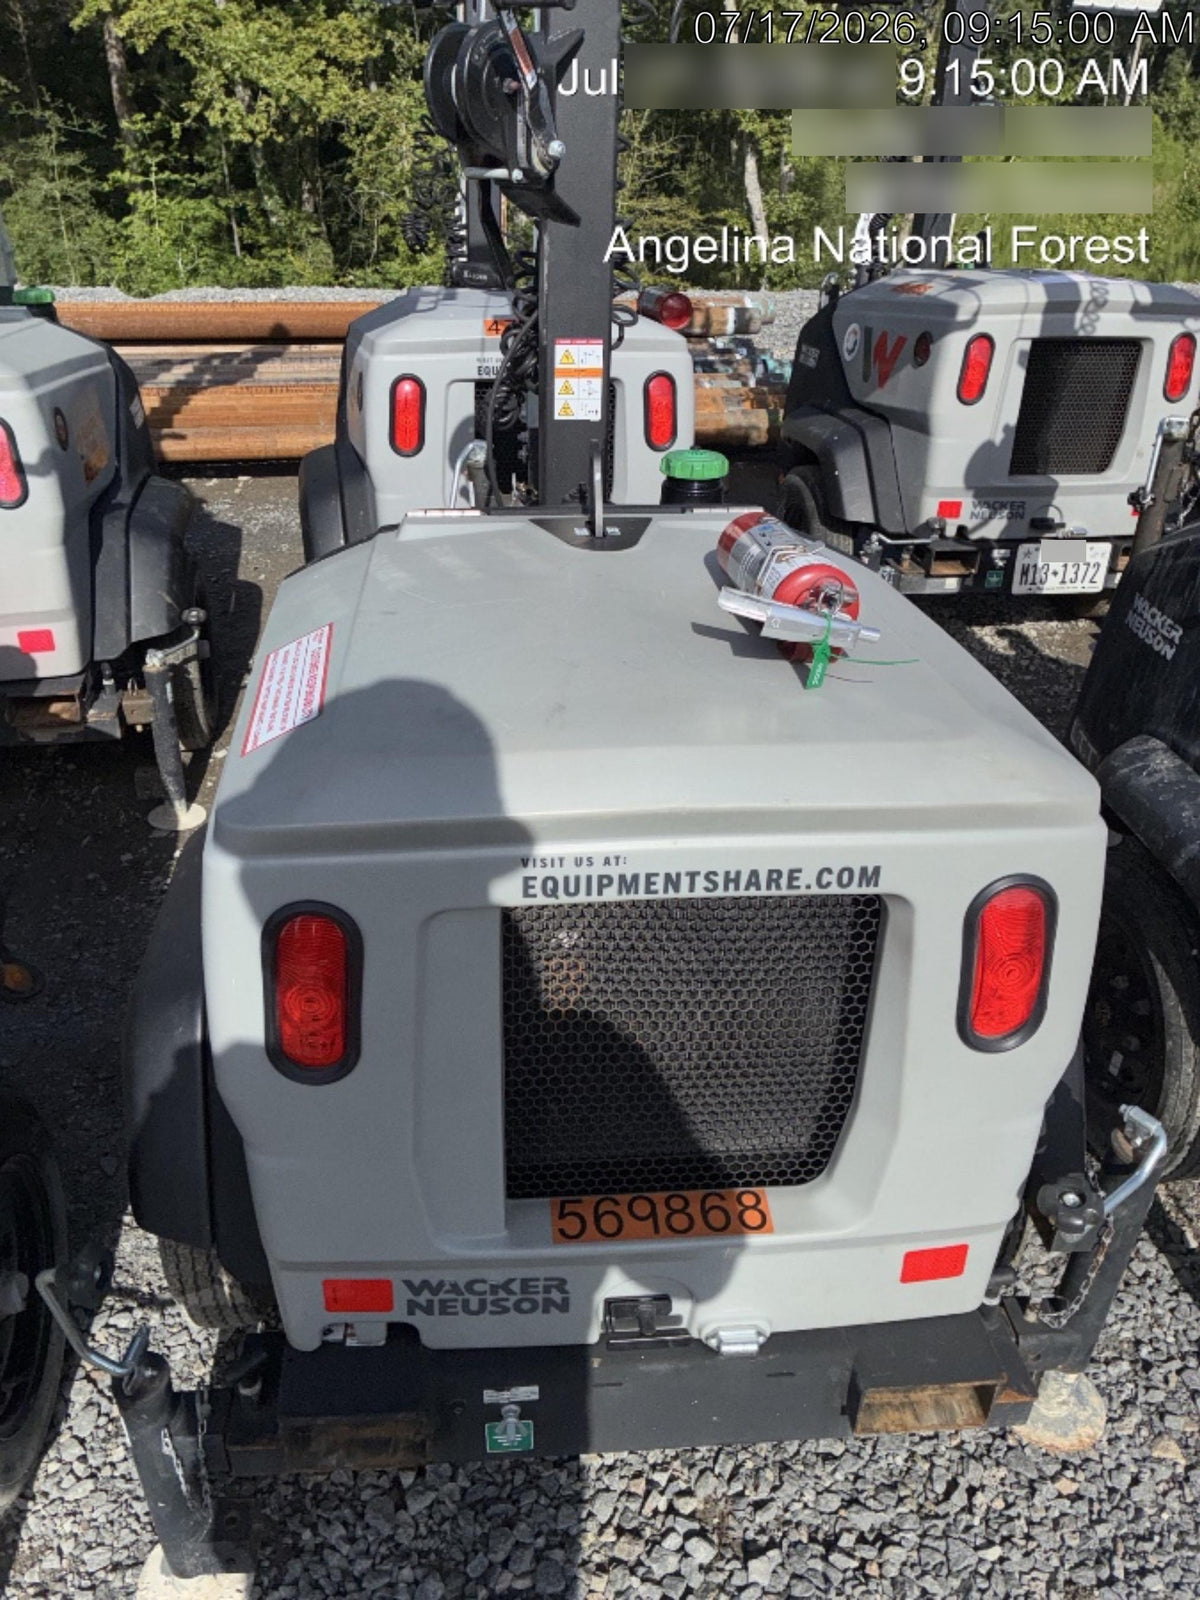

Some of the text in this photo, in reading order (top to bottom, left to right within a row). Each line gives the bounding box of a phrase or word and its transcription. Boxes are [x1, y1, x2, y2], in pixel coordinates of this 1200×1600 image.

[521, 855, 628, 868] VISIT US AT:
[522, 865, 882, 899] EQUIPMENTSHARE.COM
[556, 1189, 768, 1240] 569868
[401, 1277, 570, 1297] WACKER
[405, 1296, 570, 1317] NEUSON
